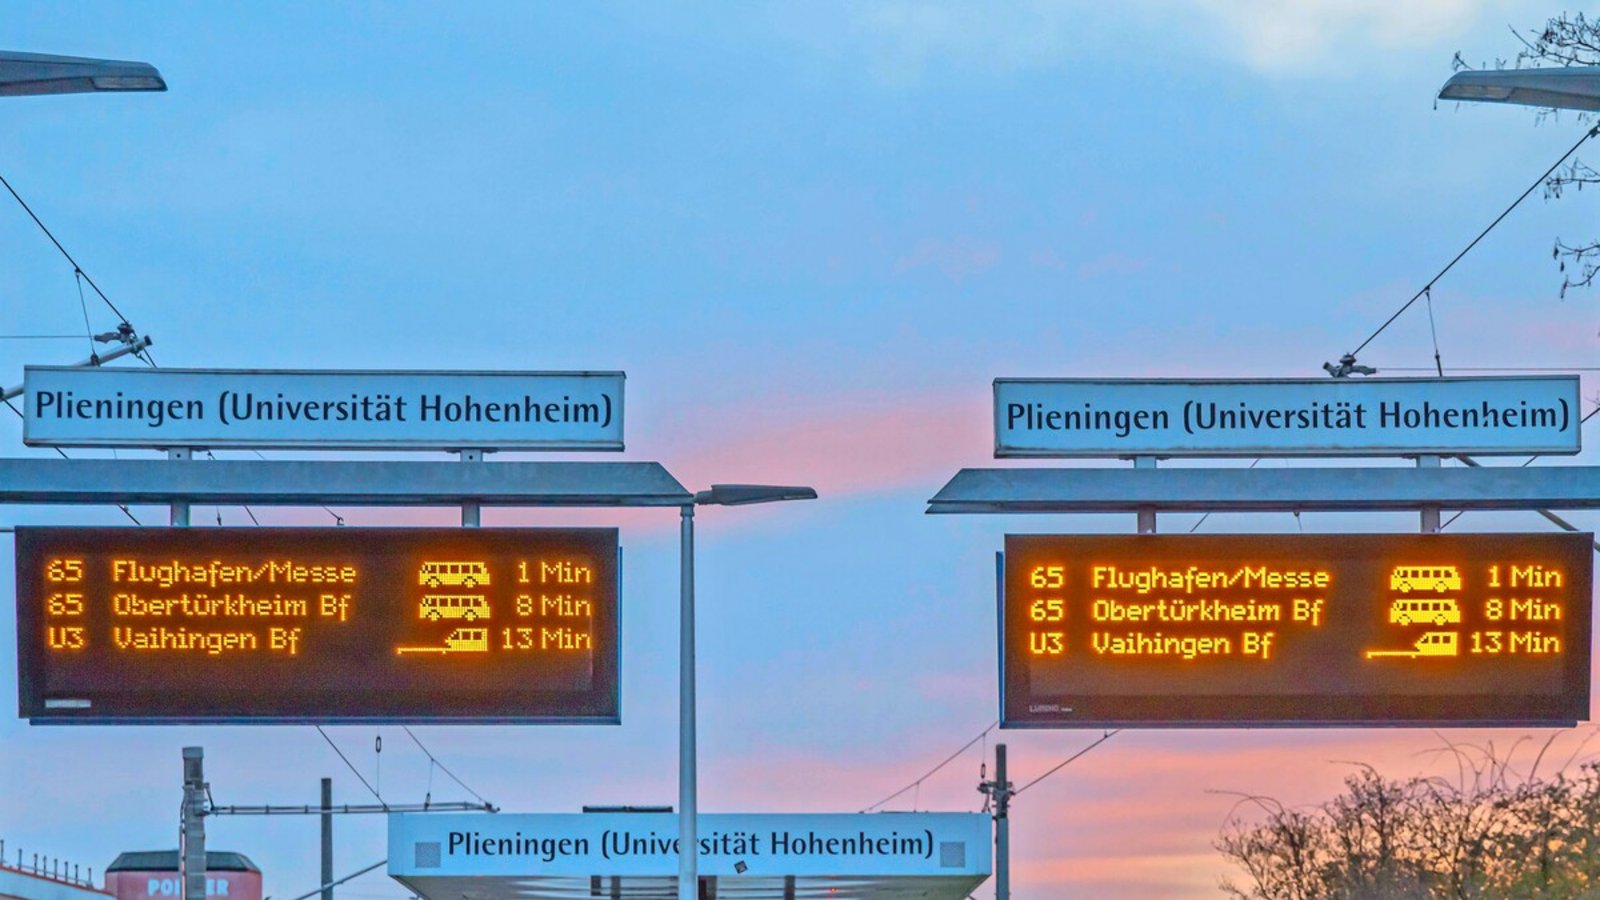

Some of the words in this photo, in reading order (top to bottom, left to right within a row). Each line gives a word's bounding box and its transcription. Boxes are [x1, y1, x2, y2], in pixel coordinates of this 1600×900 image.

[37, 391, 203, 427] Plieningen
[219, 391, 408, 426] (Universität
[421, 394, 611, 428] Hohenheim)
[1007, 403, 1169, 438] Plieningen
[1183, 400, 1367, 434] (Universität
[1380, 398, 1569, 432] Hohenheim)
[47, 559, 82, 582] 65
[112, 559, 357, 587] Flughafen/Messe
[518, 561, 530, 582] 1
[541, 561, 592, 583] Min
[1030, 565, 1065, 589] 65
[1091, 566, 1331, 593] Flughafen/Messe
[1488, 566, 1501, 588] 1
[1510, 566, 1563, 588] Min
[48, 593, 83, 615] 65
[113, 593, 307, 616] Obertürkheim
[320, 594, 351, 621] Bf
[516, 595, 533, 616] 8
[541, 594, 592, 616] Min
[1030, 599, 1064, 622] 65
[1092, 599, 1280, 622] Obertürkheim
[1292, 599, 1324, 627] Bf
[1485, 599, 1503, 620] 8
[1509, 599, 1561, 620] Min
[49, 627, 84, 649] U3
[114, 627, 256, 655] Vaihingen
[270, 627, 301, 655] Bf
[502, 627, 533, 650] 13
[541, 627, 592, 649] Min
[1029, 632, 1064, 655] U3
[1091, 632, 1231, 659] Vaihingen
[1242, 632, 1275, 659] Bf
[1471, 632, 1502, 654] 13
[1509, 632, 1560, 653] Min
[448, 832, 588, 862] Plieningen
[602, 830, 760, 859] (Univesität
[772, 830, 933, 859] Hohenheim)
